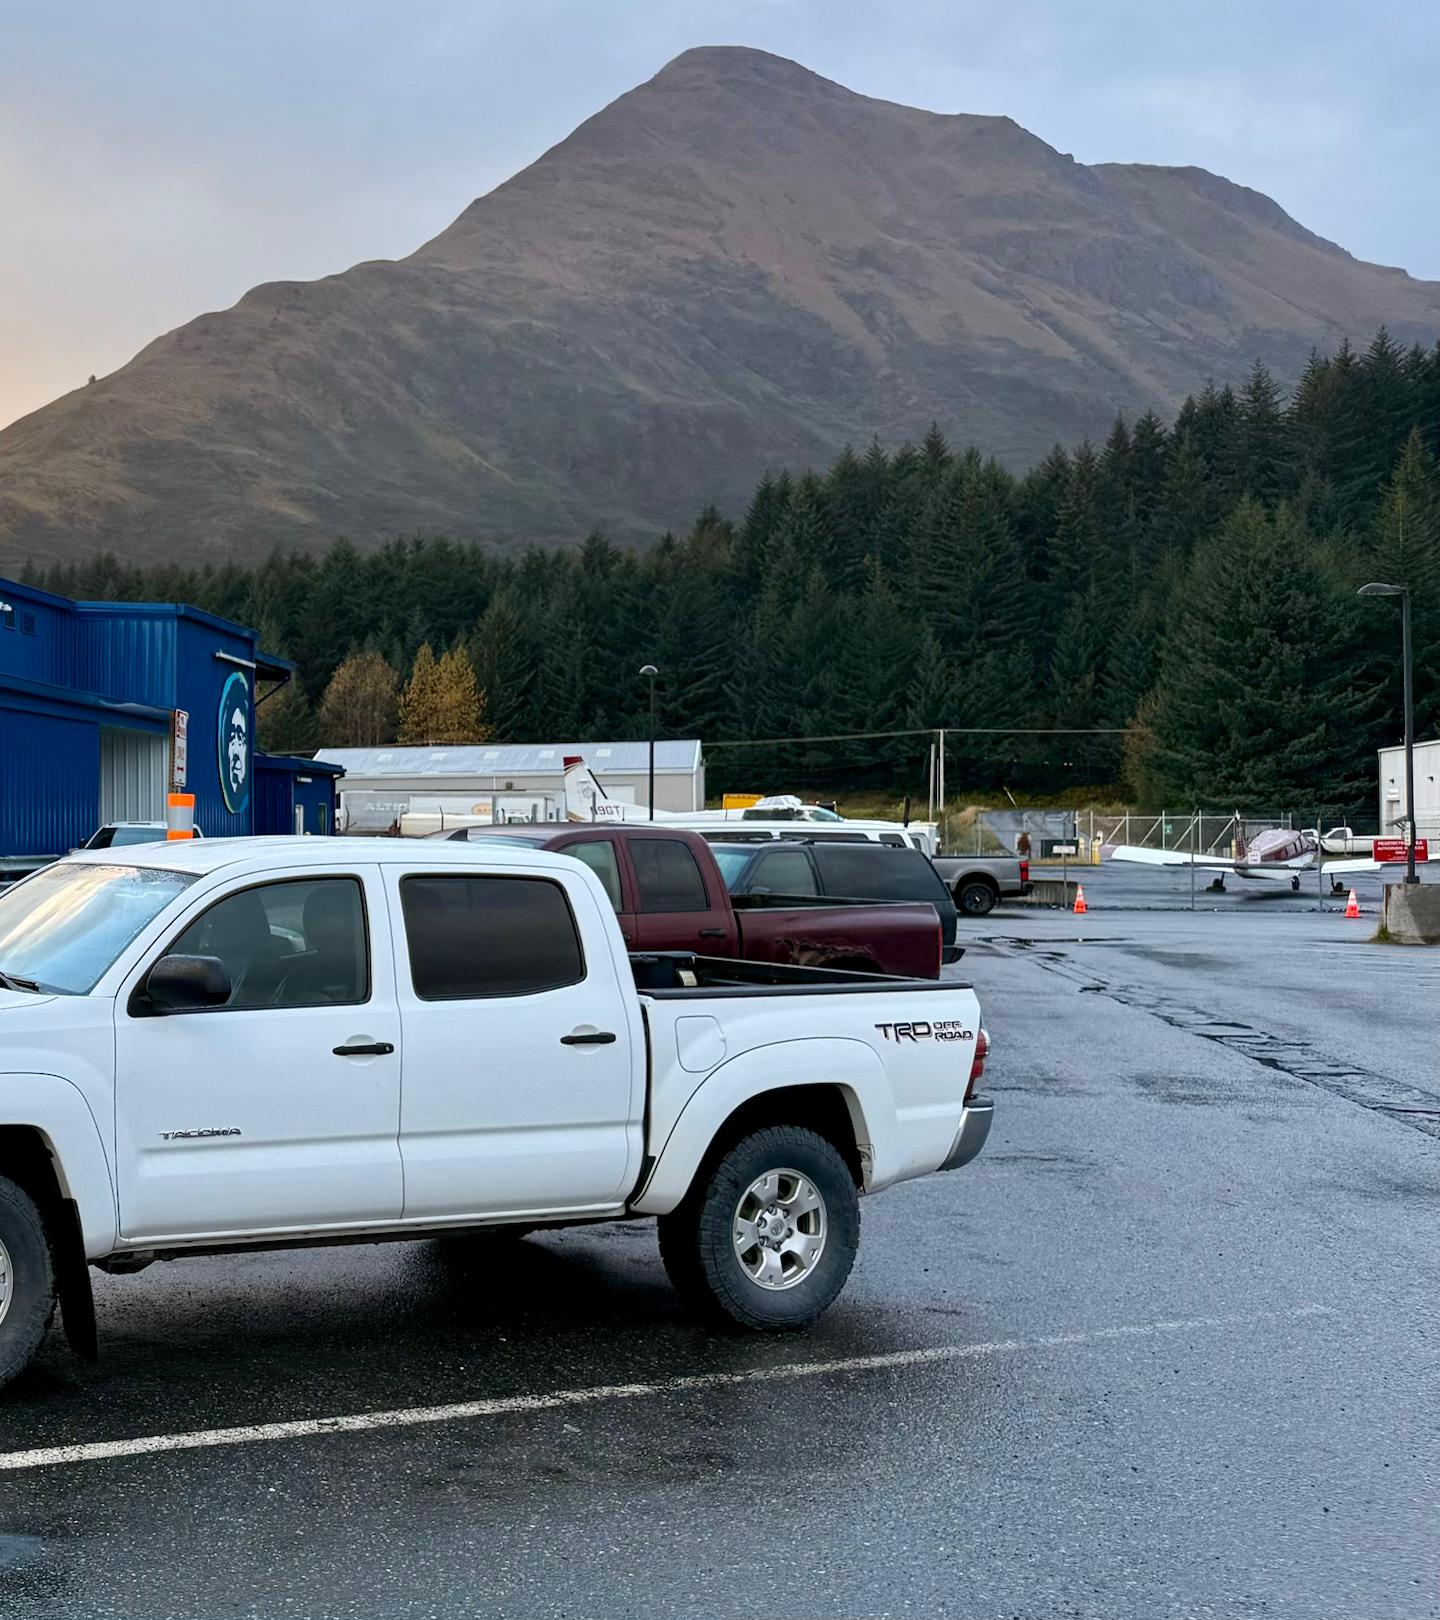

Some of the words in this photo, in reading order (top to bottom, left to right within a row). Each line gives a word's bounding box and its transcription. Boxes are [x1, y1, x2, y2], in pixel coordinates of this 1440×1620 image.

[933, 1020, 962, 1031] OFF
[874, 1021, 932, 1043] TRD
[935, 1031, 974, 1042] ROAD
[158, 1128, 242, 1140] TACOMA
